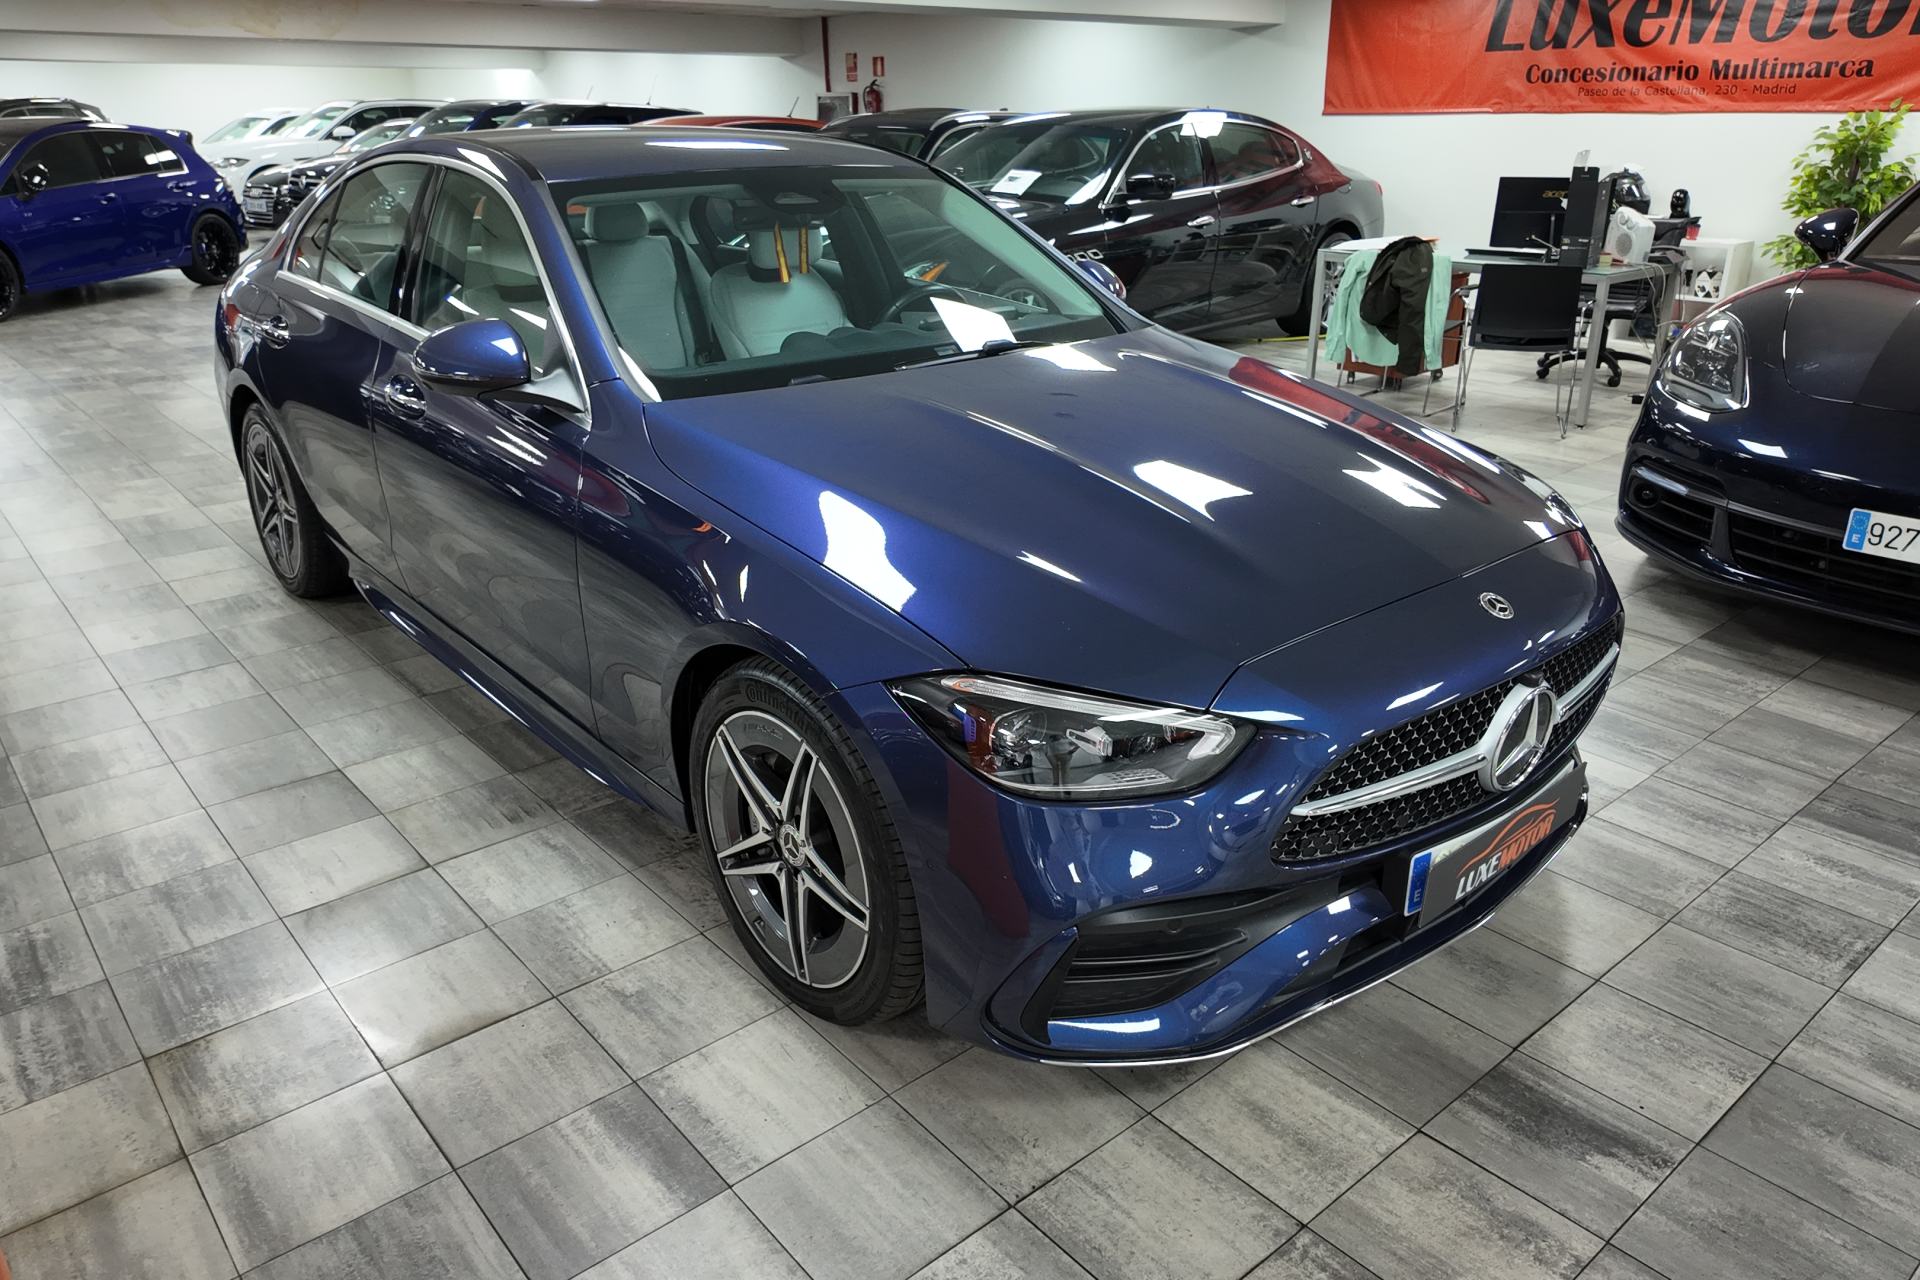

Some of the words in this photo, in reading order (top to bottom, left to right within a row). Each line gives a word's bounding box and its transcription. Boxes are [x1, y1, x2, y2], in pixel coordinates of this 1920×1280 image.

[1526, 60, 1699, 84] Concesionario
[1709, 58, 1874, 80] Multimarca
[1577, 87, 1608, 97] Paseo
[1612, 87, 1626, 96] de
[1630, 86, 1640, 96] la
[1645, 84, 1709, 96] Castellana,
[1714, 85, 1738, 95] 230
[1752, 84, 1797, 95] Madrid
[1852, 534, 1861, 543] E
